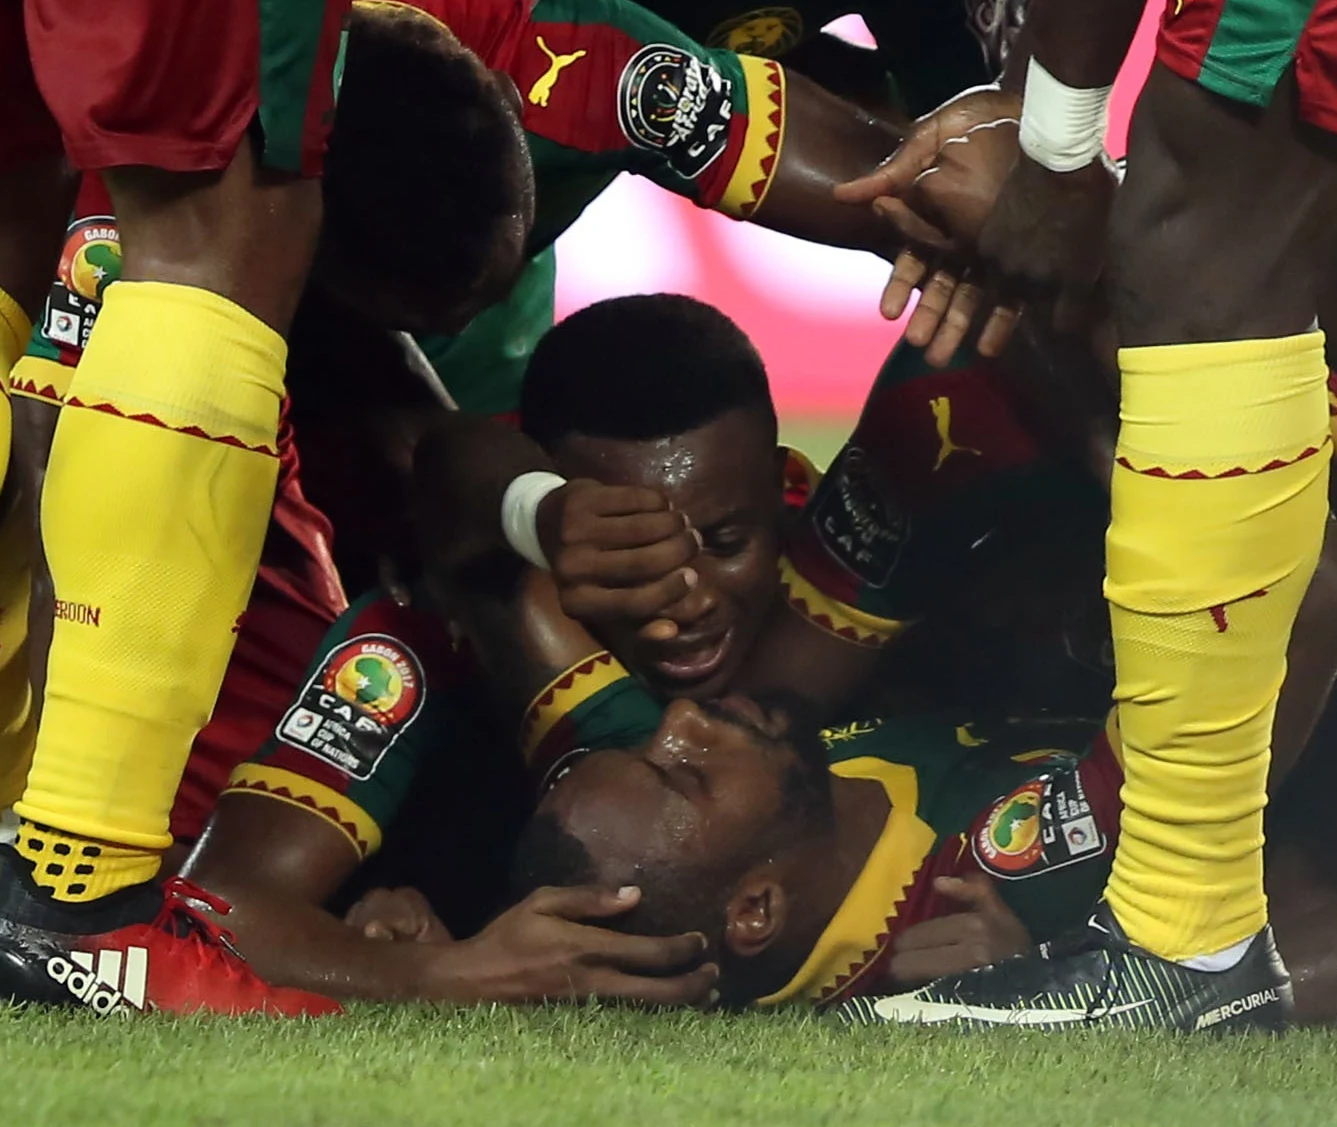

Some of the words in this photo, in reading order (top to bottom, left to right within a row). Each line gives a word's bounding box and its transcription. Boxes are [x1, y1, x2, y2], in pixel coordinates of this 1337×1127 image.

[361, 643, 400, 662] GABON
[395, 660, 414, 689] 2017
[316, 728, 335, 741] CUP
[322, 719, 352, 741] AFRICA
[47, 956, 129, 1019] adid
[1195, 988, 1280, 1031] MERCURIAL
